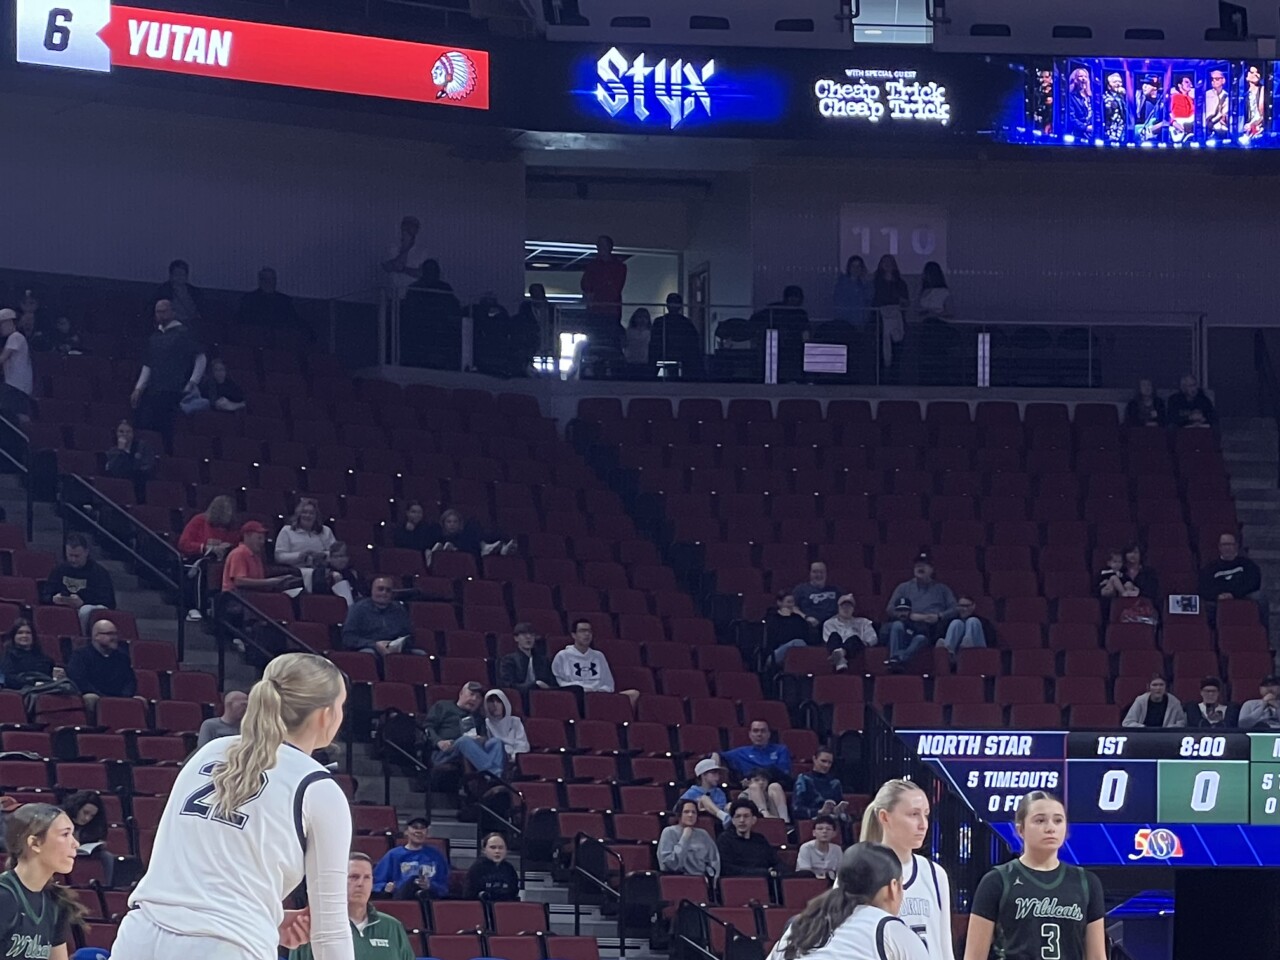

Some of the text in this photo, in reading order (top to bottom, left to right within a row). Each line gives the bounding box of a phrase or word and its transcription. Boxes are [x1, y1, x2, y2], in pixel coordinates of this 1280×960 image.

[43, 8, 73, 52] 6
[128, 19, 232, 66] YUTAN
[864, 70, 893, 78] SPECIAL
[815, 78, 946, 101] Cheap Trick
[819, 98, 885, 122] Cheap
[852, 226, 936, 256] 110
[917, 735, 1032, 756] NORTH STAR
[1097, 737, 1128, 756] 1ST
[1180, 737, 1225, 756] 8:00
[984, 771, 1058, 788] TIMEOUTS
[1098, 769, 1128, 811] 0
[1191, 770, 1220, 812] 0
[988, 795, 999, 812] 0
[1265, 798, 1275, 814] 0
[1015, 897, 1083, 921] Wildcats
[1041, 923, 1060, 960] 3
